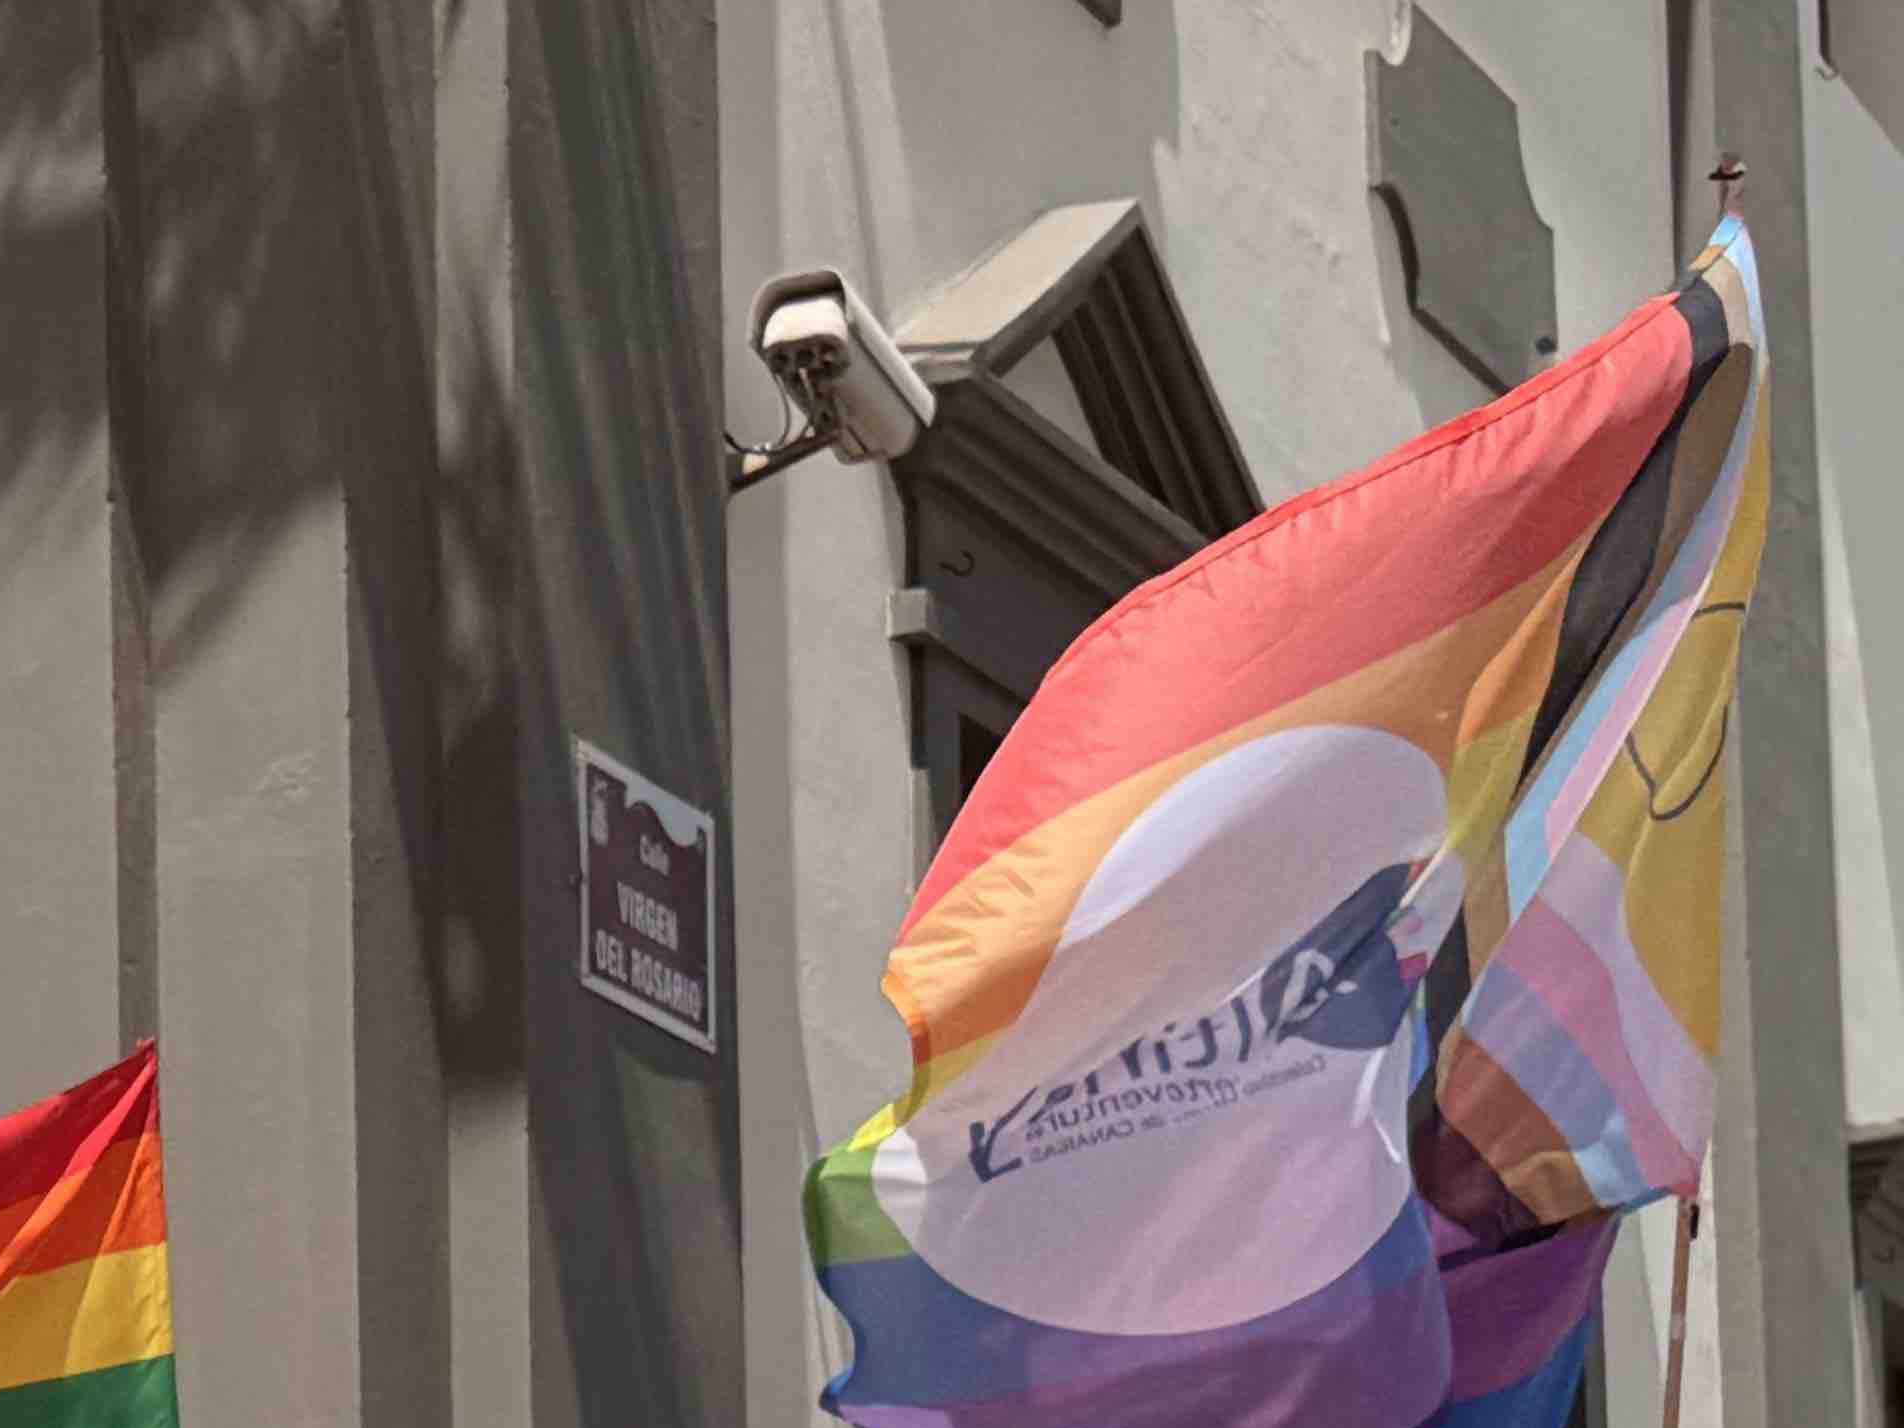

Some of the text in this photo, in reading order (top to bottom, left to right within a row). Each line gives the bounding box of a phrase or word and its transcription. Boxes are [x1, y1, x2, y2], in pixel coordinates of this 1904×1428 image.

[616, 880, 678, 951] VIRGEN
[595, 927, 703, 1023] DEL ROSARIO
